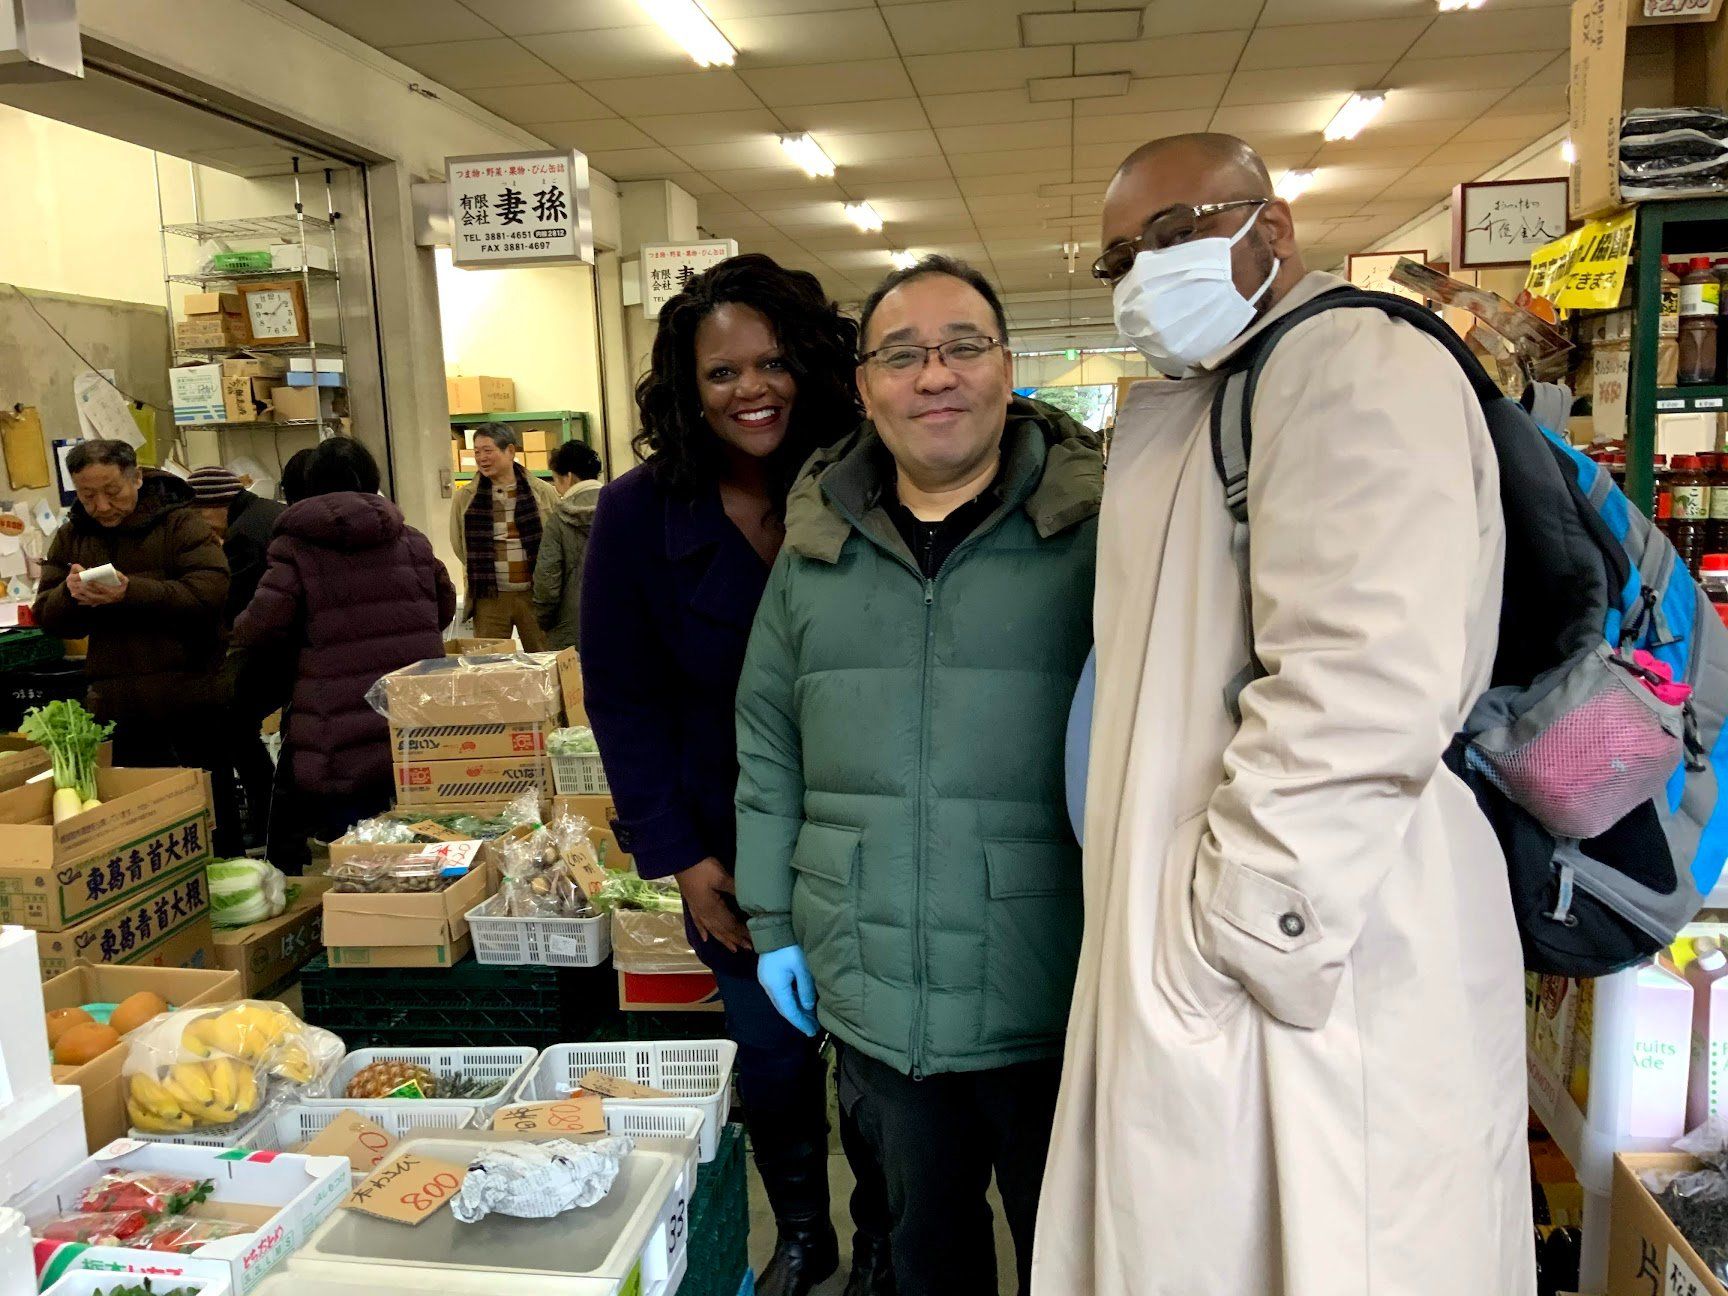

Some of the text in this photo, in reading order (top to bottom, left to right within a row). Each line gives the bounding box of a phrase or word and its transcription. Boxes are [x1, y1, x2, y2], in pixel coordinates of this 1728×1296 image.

[460, 194, 489, 210] 有限
[461, 211, 490, 226] 会社
[464, 233, 481, 242] TEL
[485, 231, 531, 241] 3881-4651
[481, 241, 551, 253] FAX 3881-4697
[651, 268, 671, 280] 有限
[652, 280, 672, 291] 会社
[1636, 1040, 1676, 1055] ruits
[400, 1173, 459, 1211] 800
